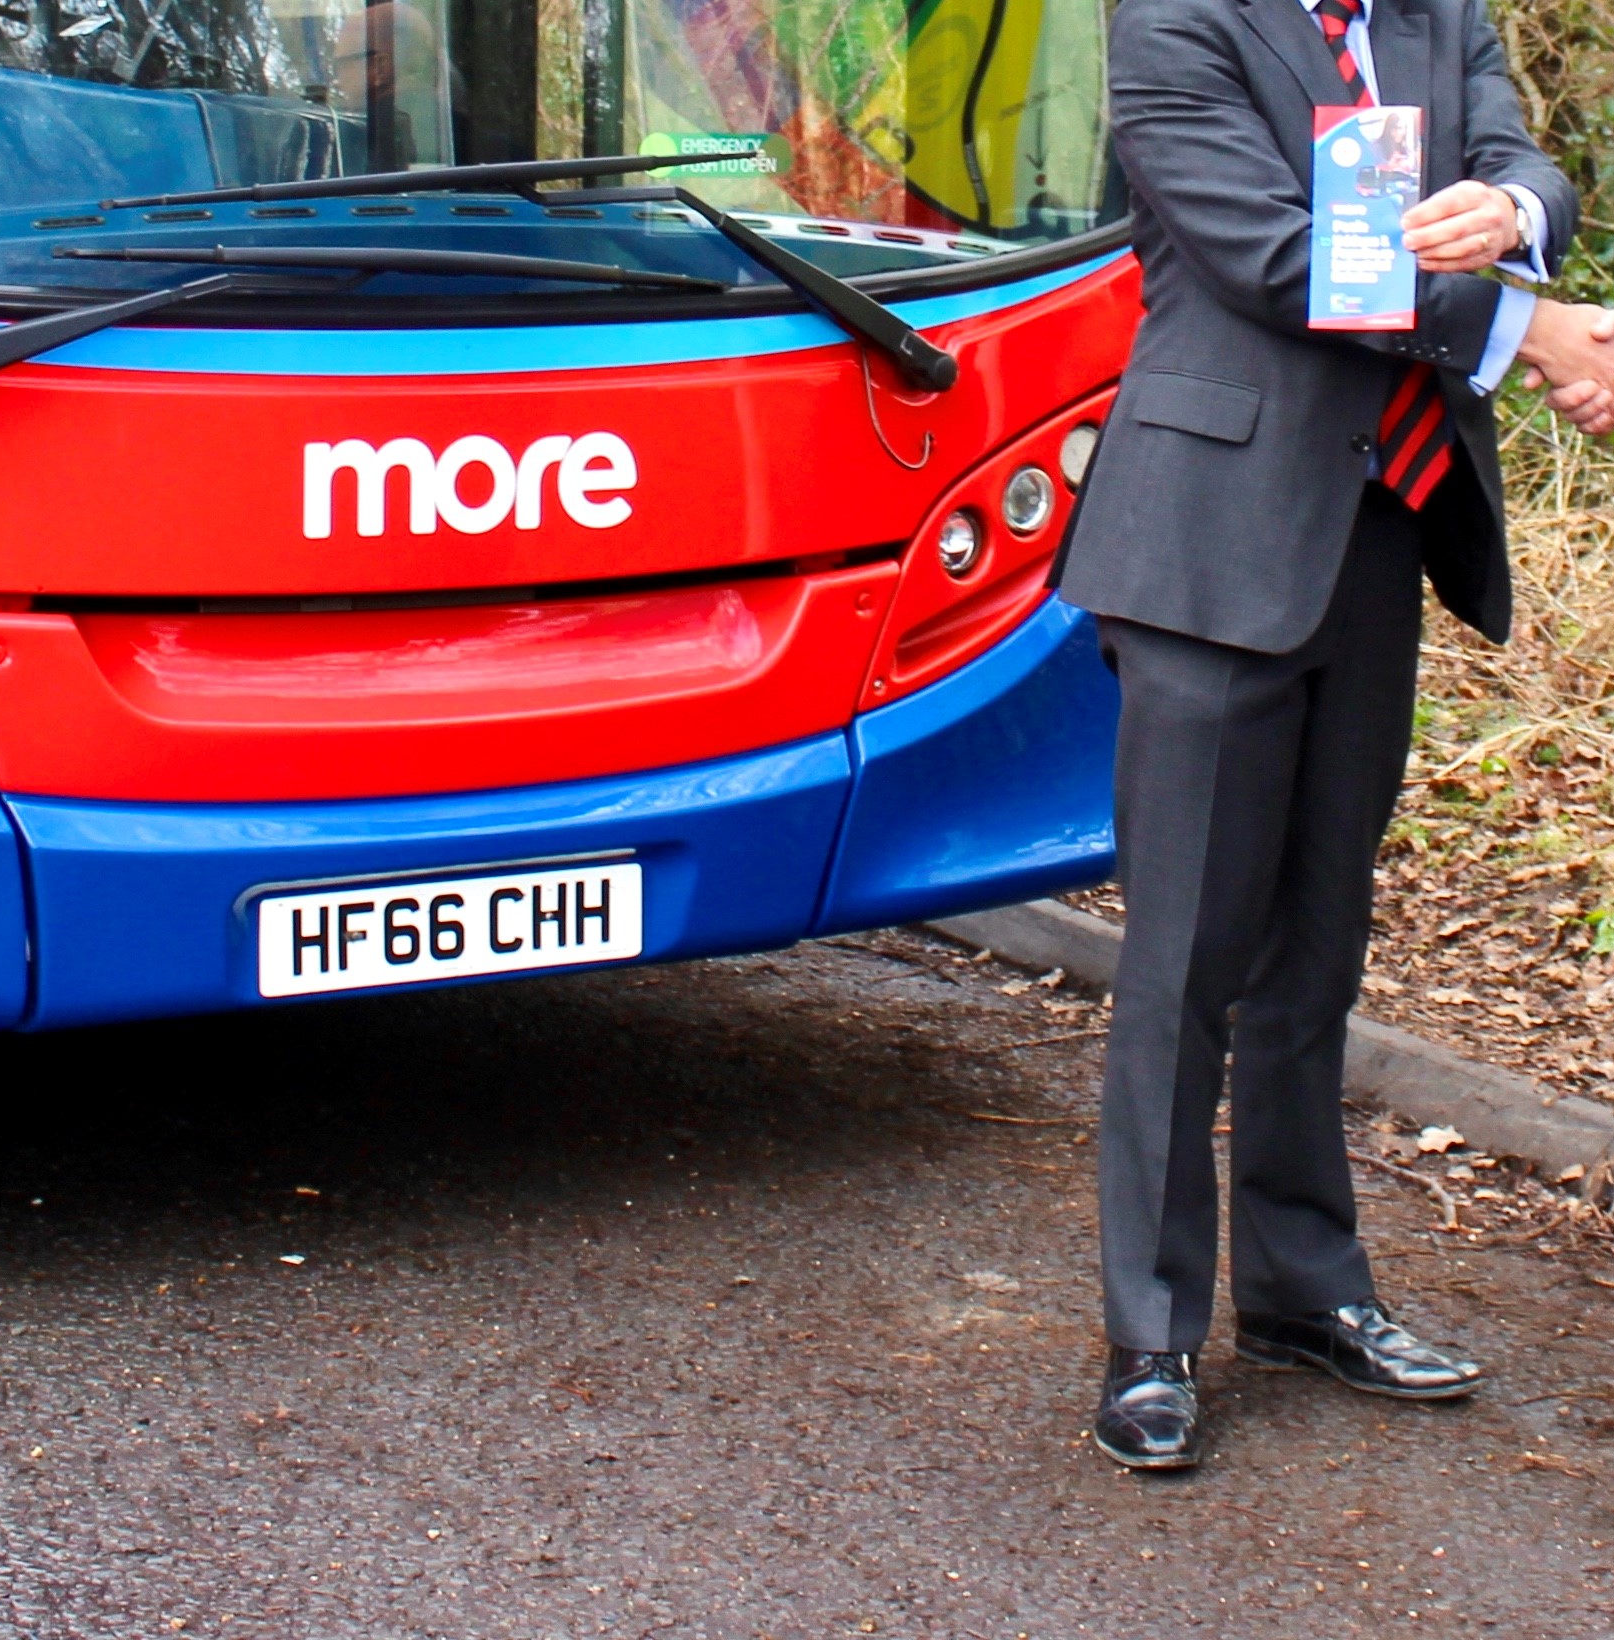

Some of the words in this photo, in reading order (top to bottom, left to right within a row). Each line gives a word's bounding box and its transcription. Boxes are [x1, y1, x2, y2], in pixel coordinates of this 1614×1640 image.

[681, 138, 762, 154] EMERGENCY
[740, 157, 778, 173] OPEN
[303, 431, 638, 539] more
[292, 893, 465, 977] HF66
[489, 878, 611, 955] CHH
